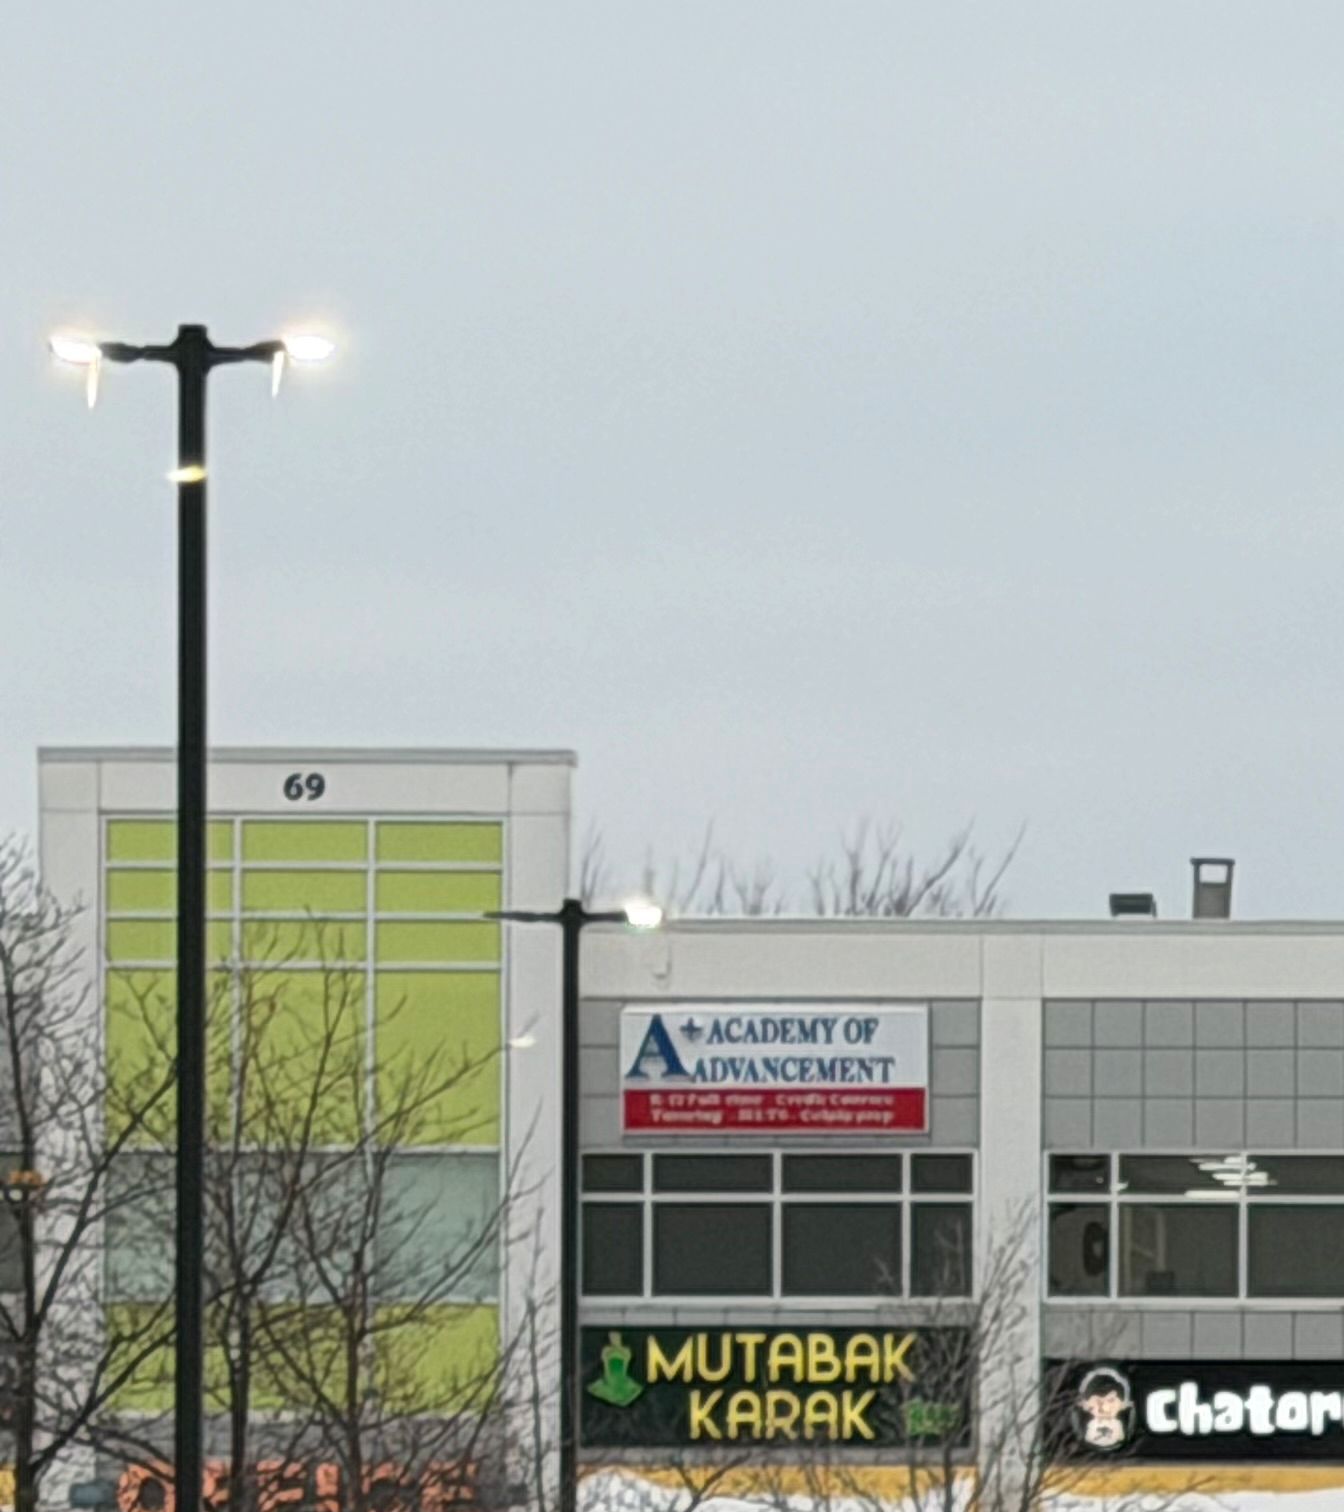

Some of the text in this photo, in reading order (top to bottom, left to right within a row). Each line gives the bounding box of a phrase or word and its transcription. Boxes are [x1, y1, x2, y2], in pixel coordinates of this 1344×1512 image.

[283, 773, 325, 800] 69
[707, 1018, 837, 1045] ACADEMY
[844, 1018, 879, 1045] OF
[692, 1057, 896, 1084] ADVANCEMENT
[646, 1332, 919, 1384] MUTABAK
[689, 1389, 876, 1440] KARAK
